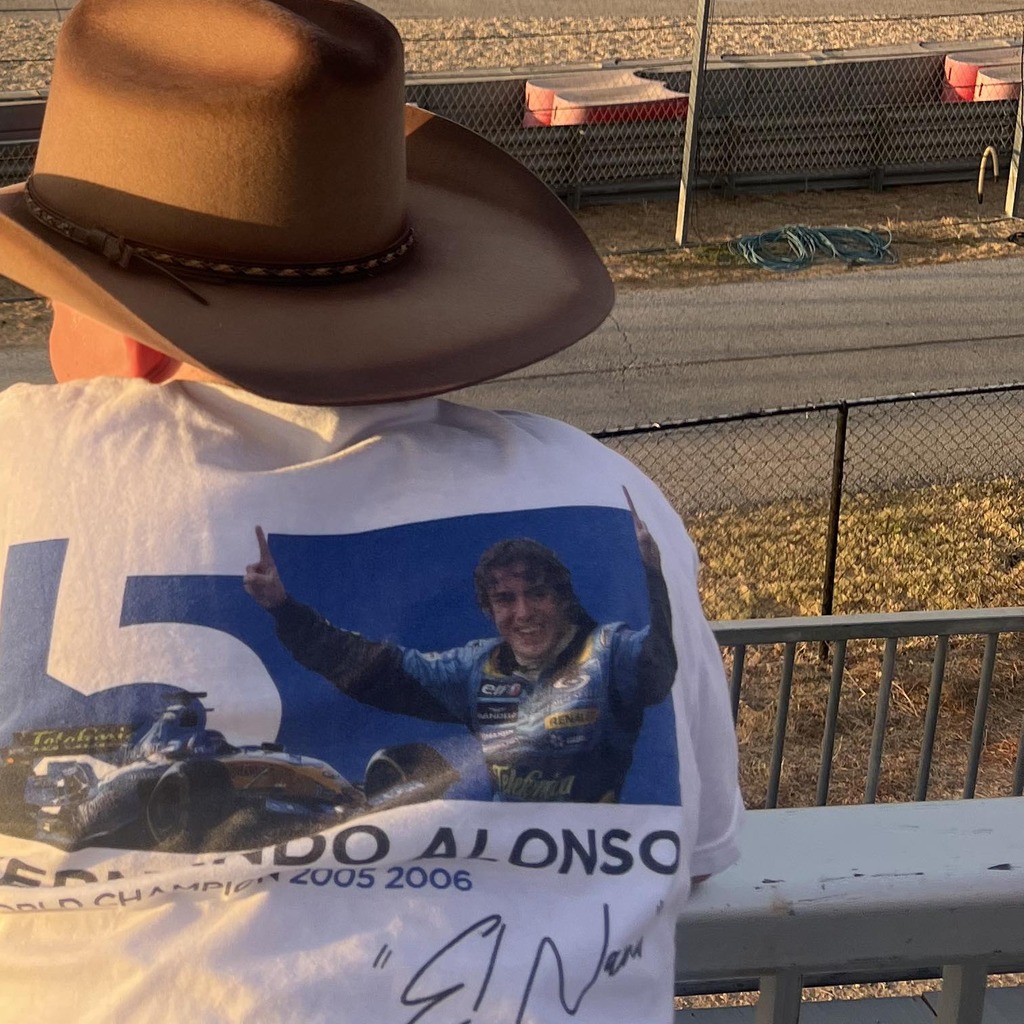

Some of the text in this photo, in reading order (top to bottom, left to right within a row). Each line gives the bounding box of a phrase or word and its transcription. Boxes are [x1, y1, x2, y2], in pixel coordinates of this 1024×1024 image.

[413, 827, 680, 876] ALONSO
[290, 868, 375, 888] 2005
[384, 866, 473, 891] 2006
